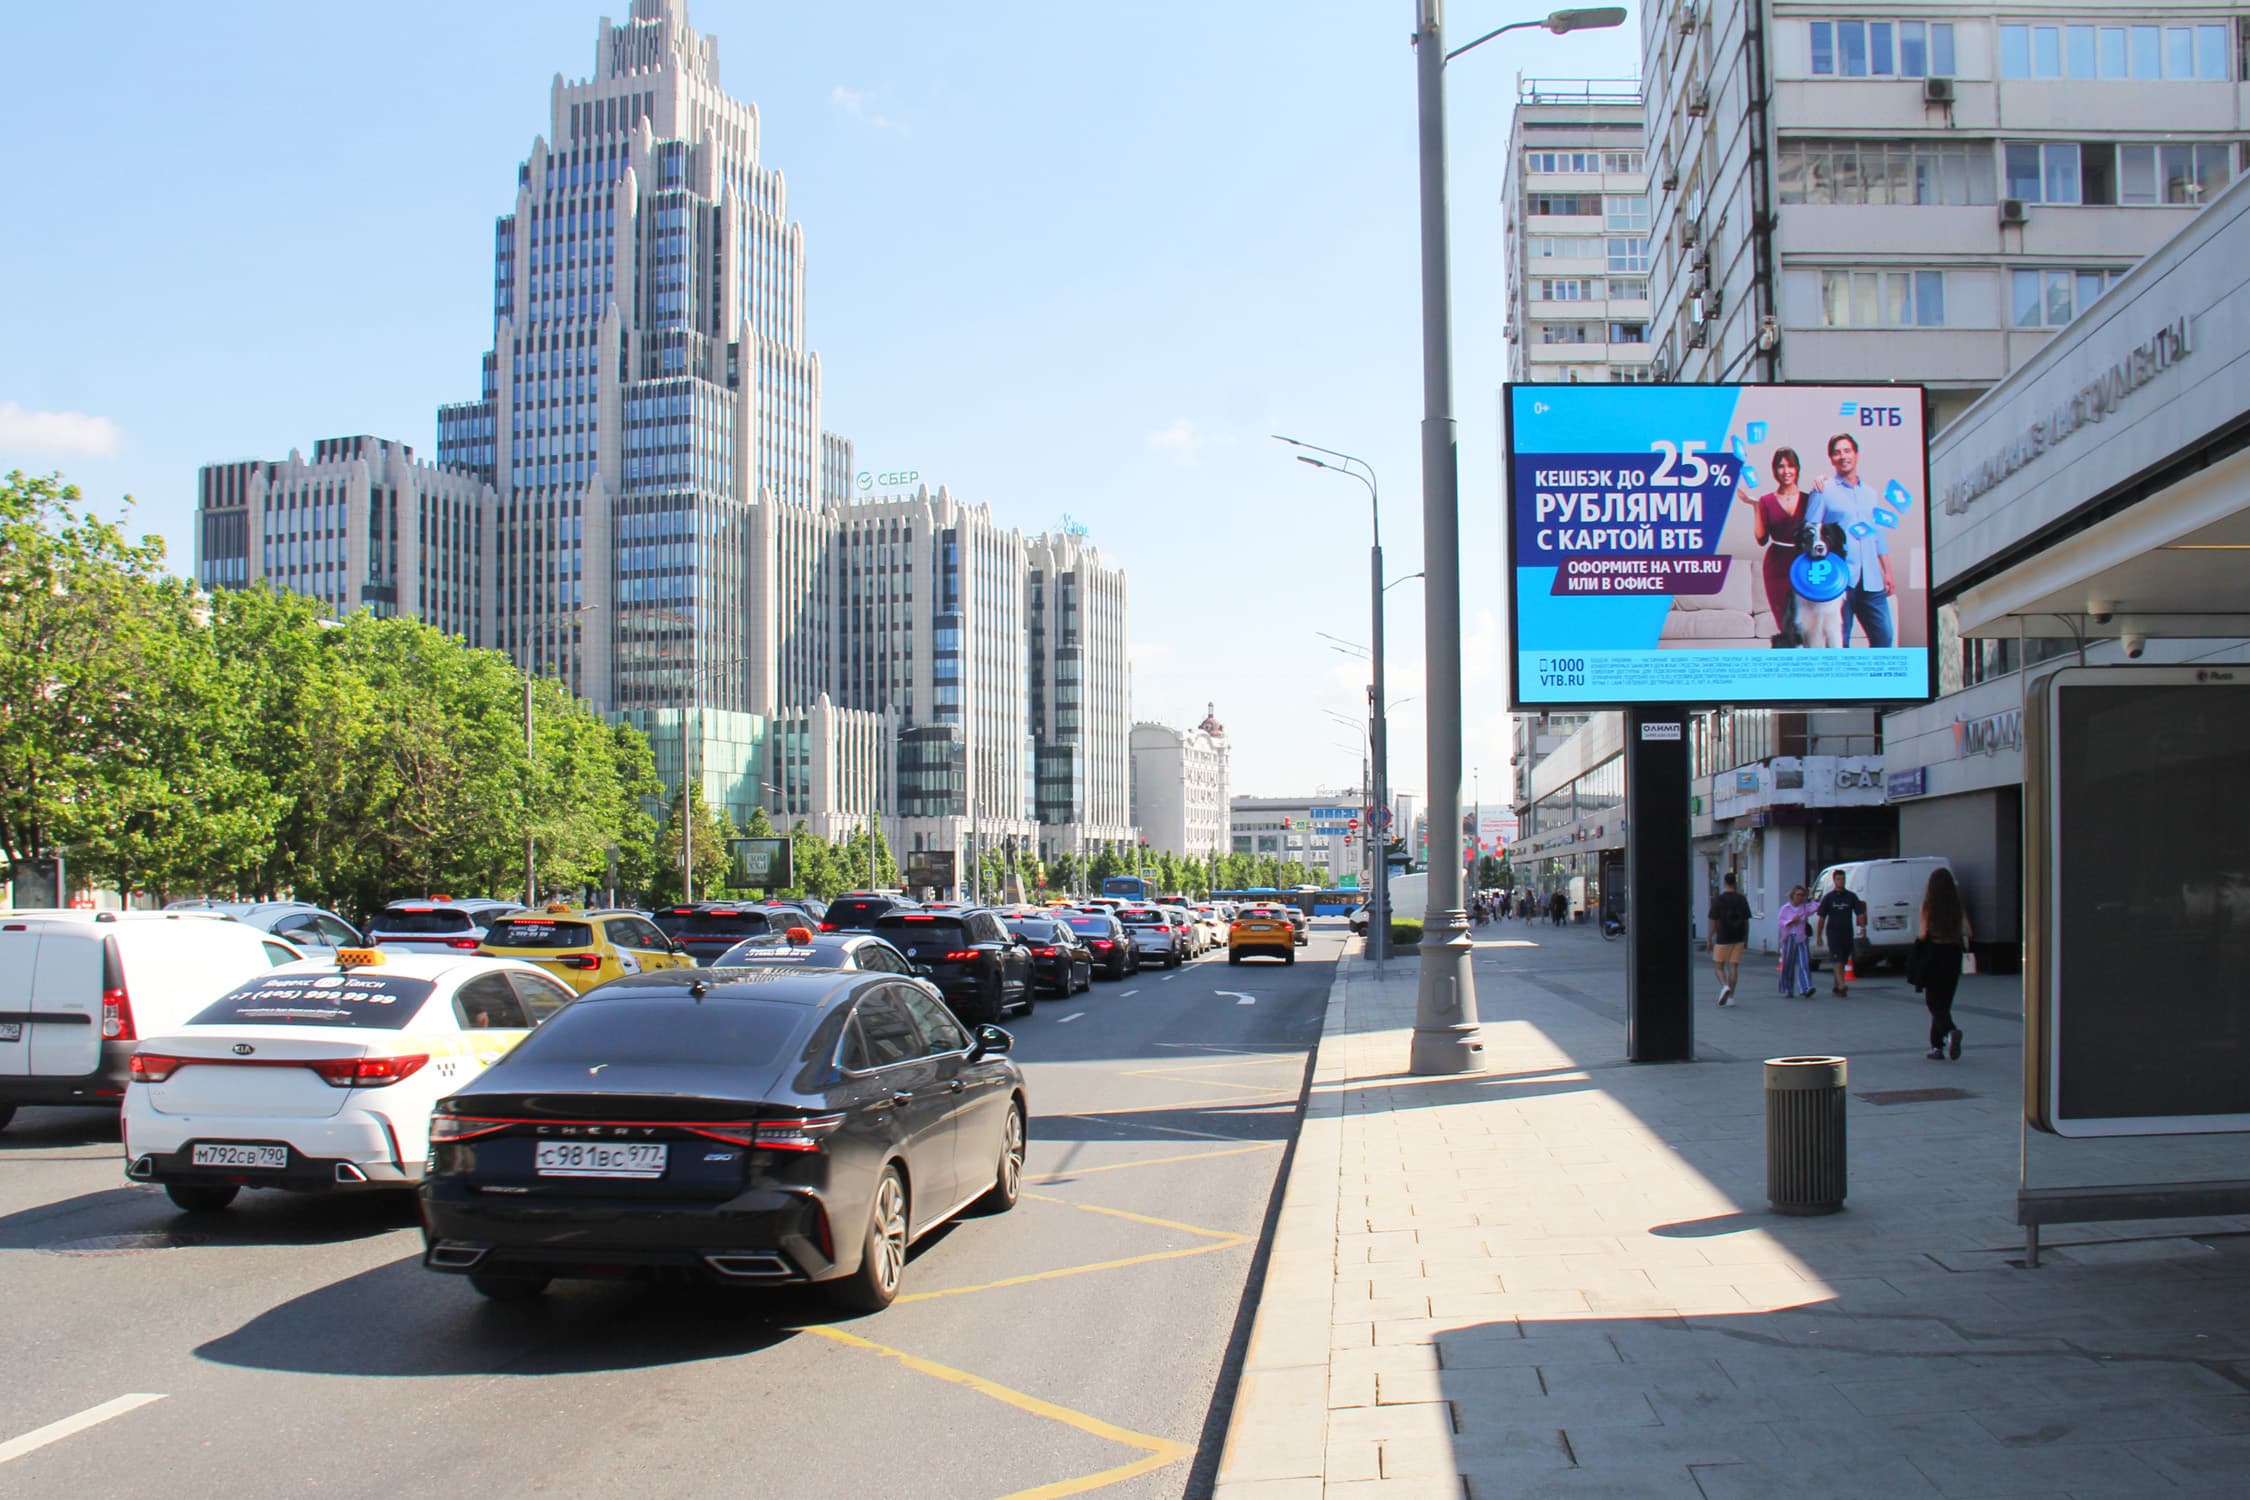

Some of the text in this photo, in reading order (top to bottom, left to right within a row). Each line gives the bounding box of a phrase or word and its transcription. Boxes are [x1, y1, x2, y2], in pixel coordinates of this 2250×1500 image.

[1860, 407, 1902, 426] ВТБ
[1535, 440, 1731, 489] КЕШБЭК ДО 25%
[879, 471, 919, 485] СБЕР
[1536, 492, 1703, 522] РУБЛЯМИ
[1537, 523, 1703, 550] С КАРТОЙ ВТБ
[1568, 561, 1722, 574] ОФОРМИТЕ НА VTB.RU
[1568, 577, 1664, 590] ИЛИ В ОФИСЕ
[1550, 658, 1584, 672] 1000
[1540, 674, 1585, 686] VTB.RU
[344, 978, 387, 989] Такси
[229, 992, 252, 1000] +7
[303, 991, 342, 1000] 999
[342, 992, 368, 1001] 99
[368, 994, 398, 1004] 99
[234, 1045, 251, 1055] KIA
[536, 1126, 655, 1136] CHERY
[198, 1147, 283, 1164] М792СВ 790
[542, 1145, 659, 1168] С981ВС 977
